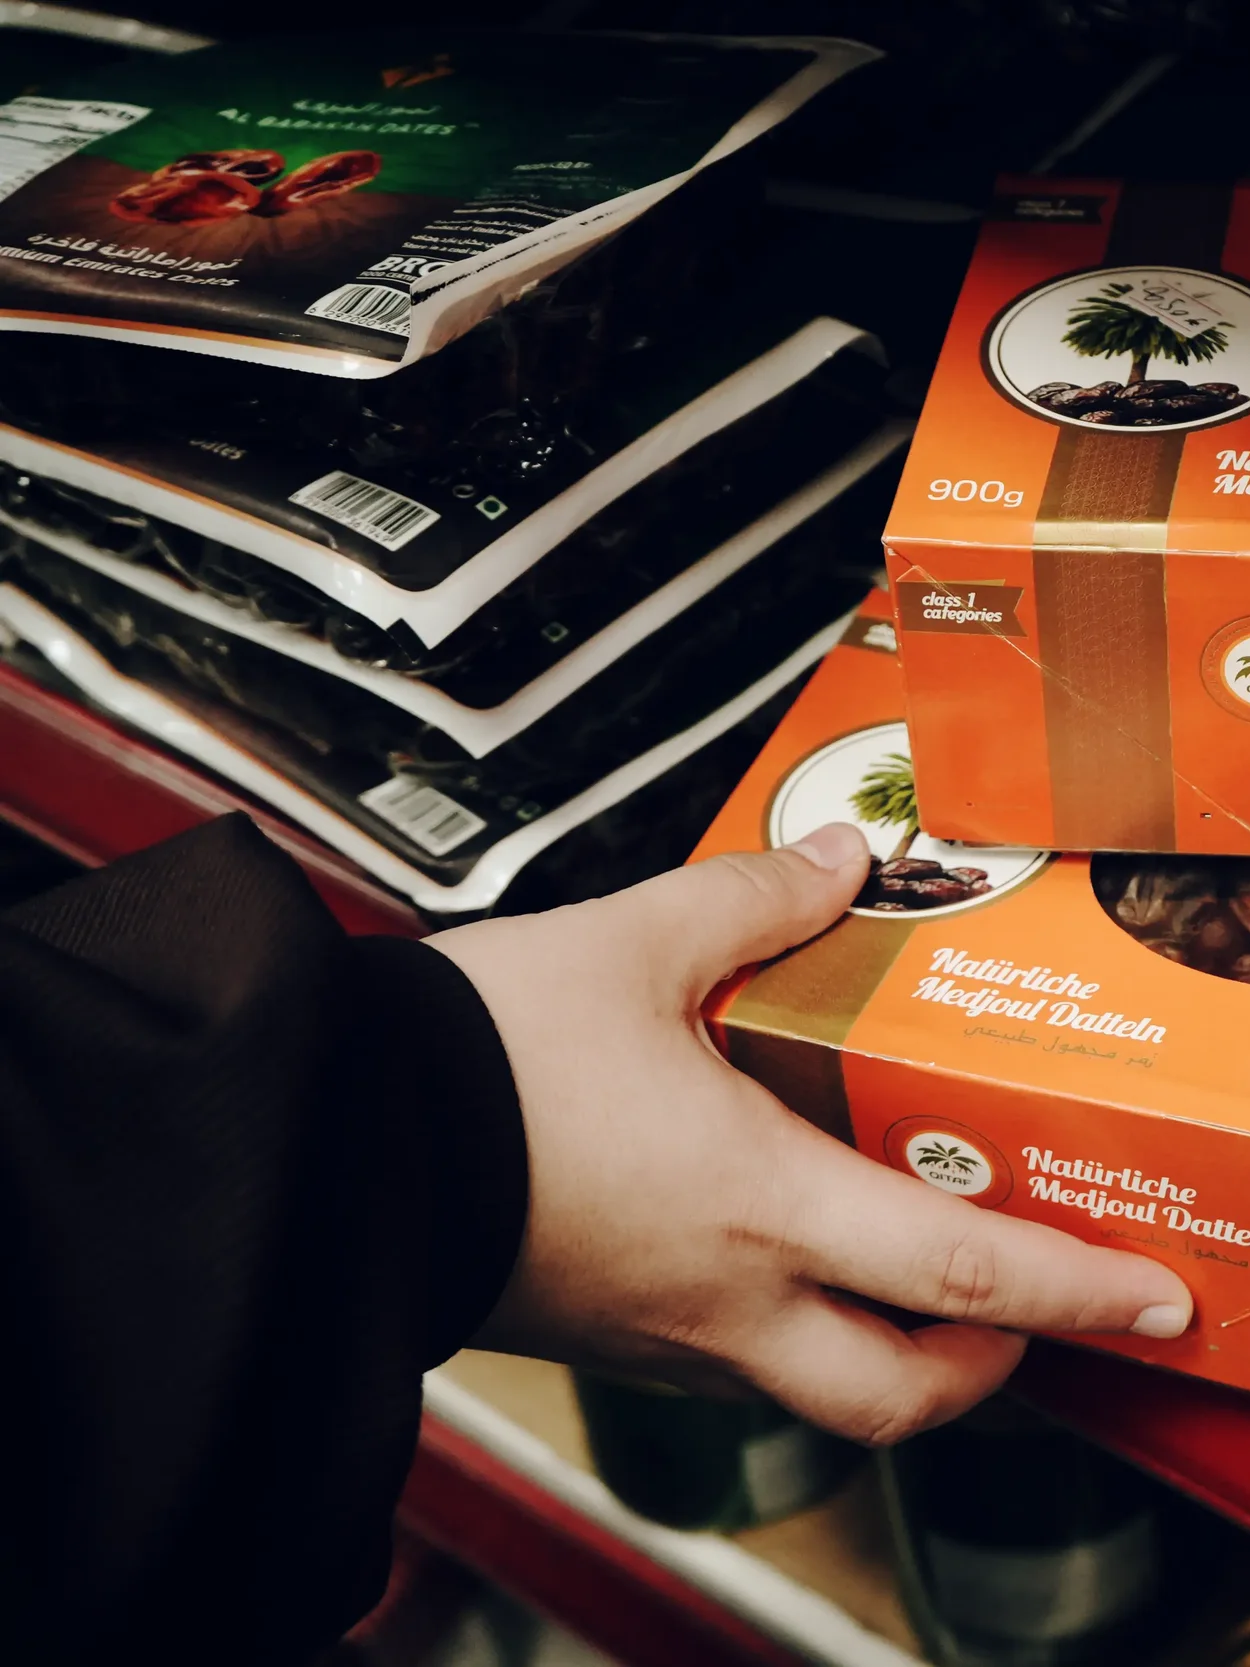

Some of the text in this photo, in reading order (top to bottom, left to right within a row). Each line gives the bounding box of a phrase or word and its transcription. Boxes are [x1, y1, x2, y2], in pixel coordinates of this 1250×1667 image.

[376, 122, 457, 136] DATES
[0, 245, 241, 288] mium Emirates Dates
[927, 479, 1024, 508] 900g
[921, 591, 976, 608] class 1
[923, 606, 1003, 624] categories
[929, 948, 1100, 1000] Natürliche
[911, 976, 1167, 1044] Medjoul Datteln
[963, 1024, 1037, 1045] طبيعي
[1041, 1036, 1118, 1061] مجهول
[928, 1171, 972, 1186] QITAF
[1021, 1146, 1198, 1205] Natürliche
[1028, 1176, 1157, 1219] Medjoul
